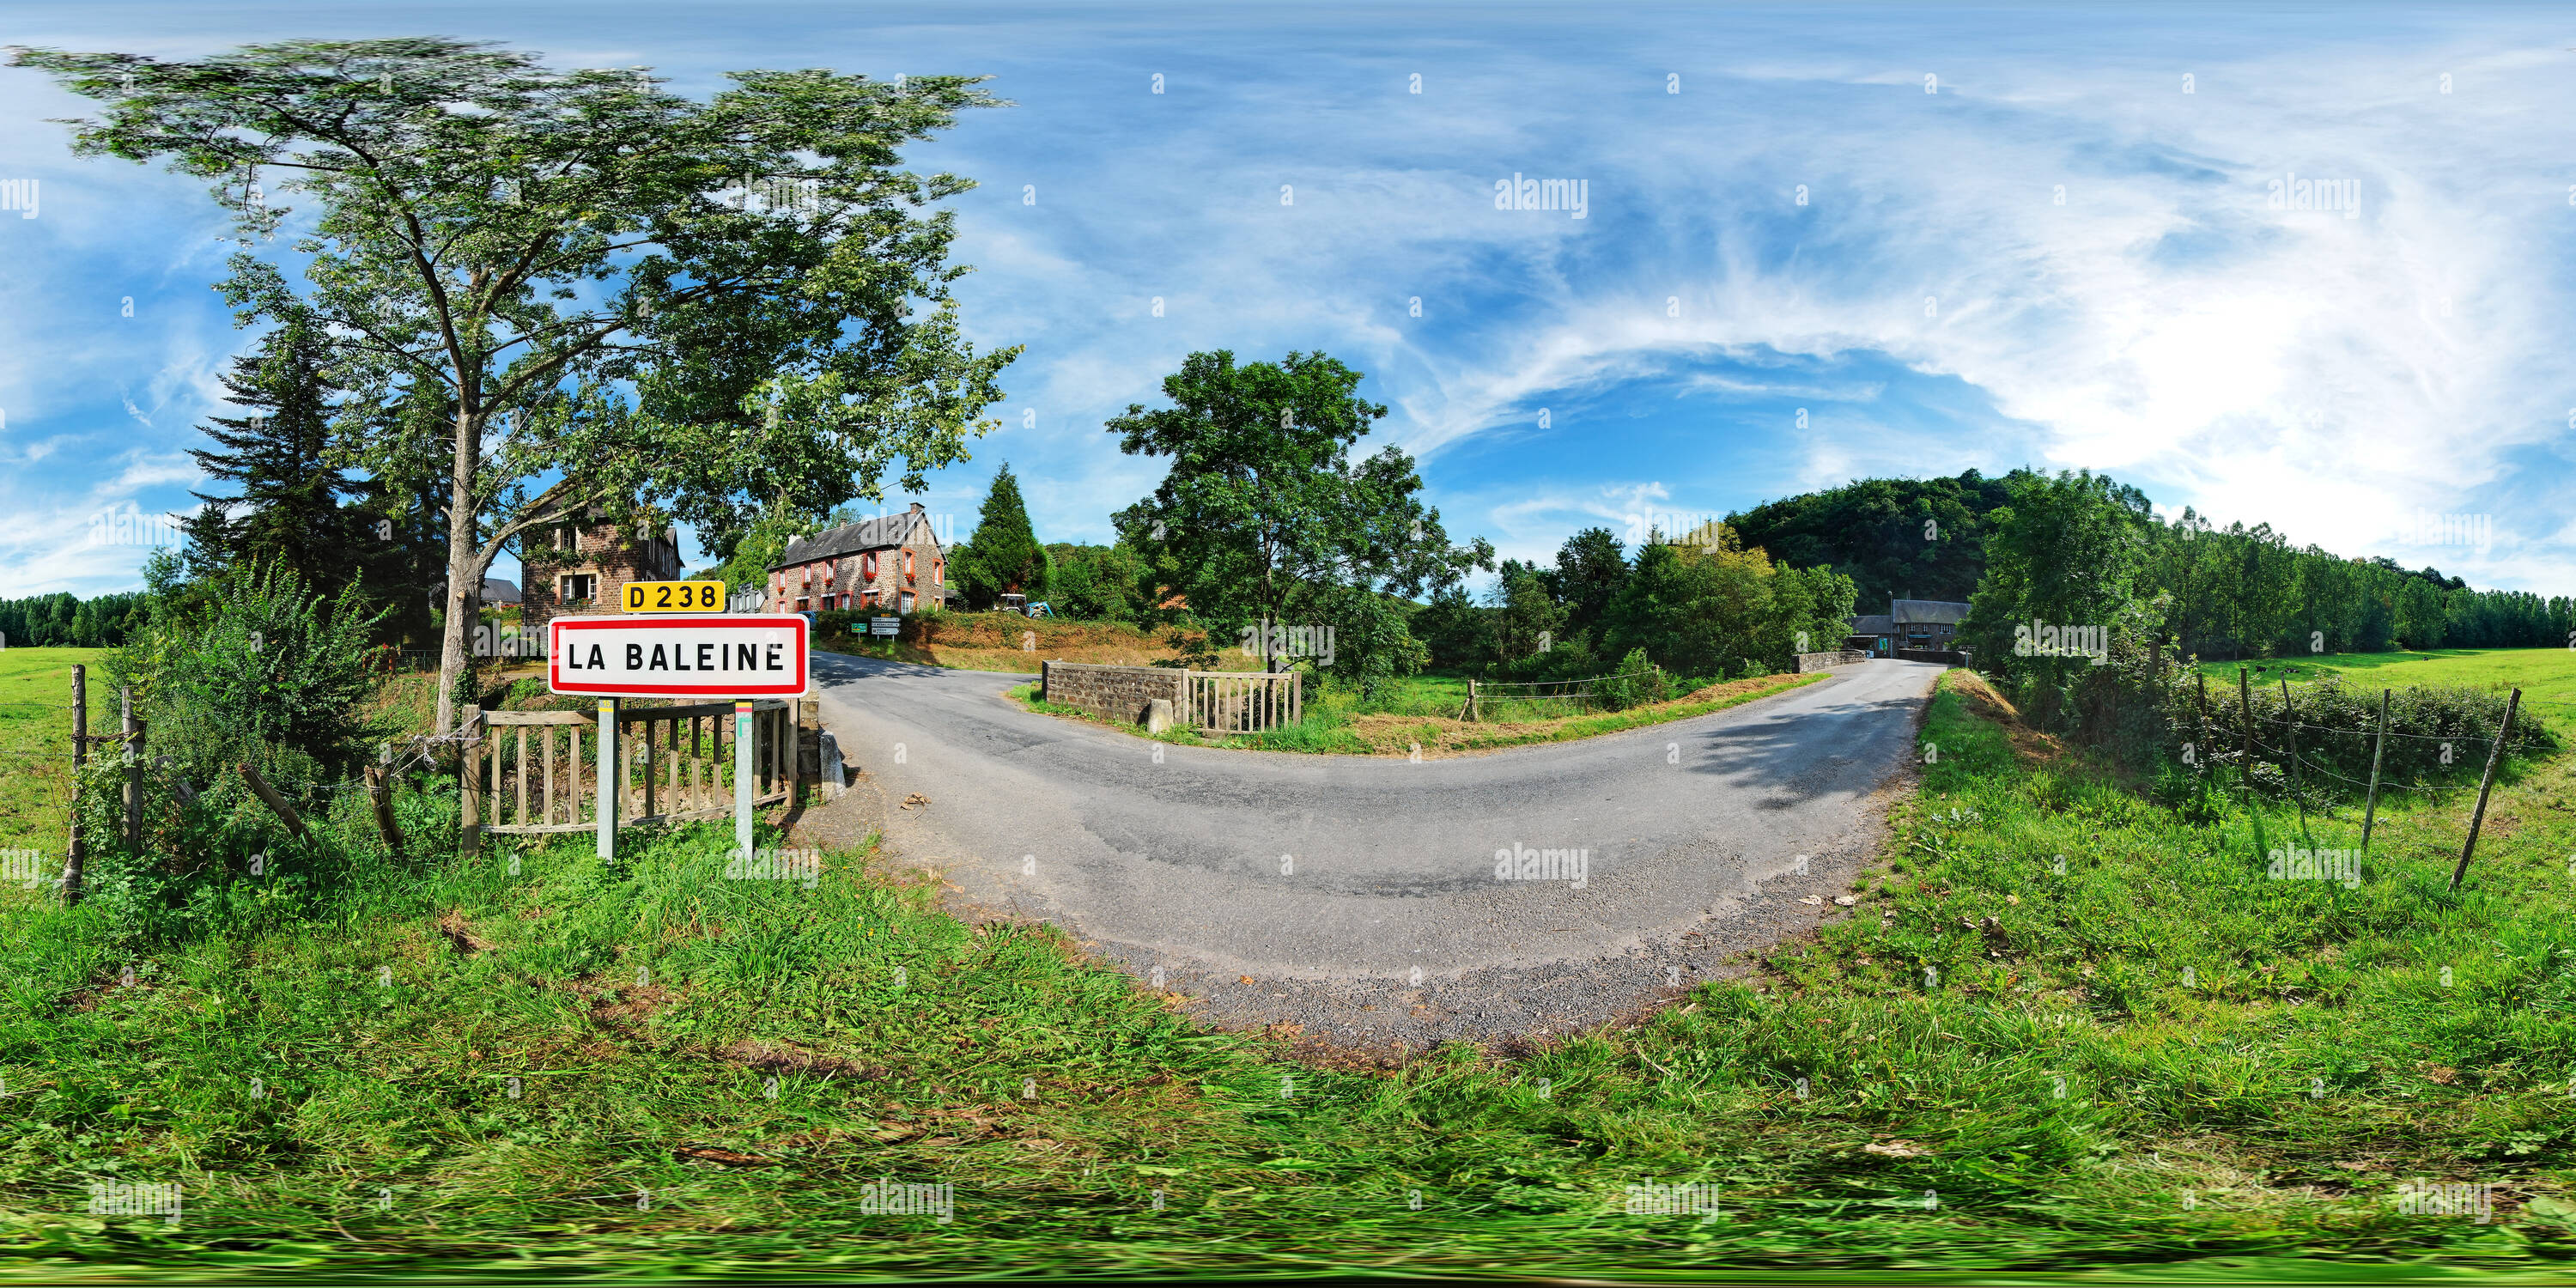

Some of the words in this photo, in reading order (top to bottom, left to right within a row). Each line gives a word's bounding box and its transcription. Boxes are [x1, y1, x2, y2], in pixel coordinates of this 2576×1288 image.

[630, 586, 645, 608] D
[657, 586, 716, 608] 238
[568, 643, 605, 670] LA
[626, 643, 784, 671] BALEINE
